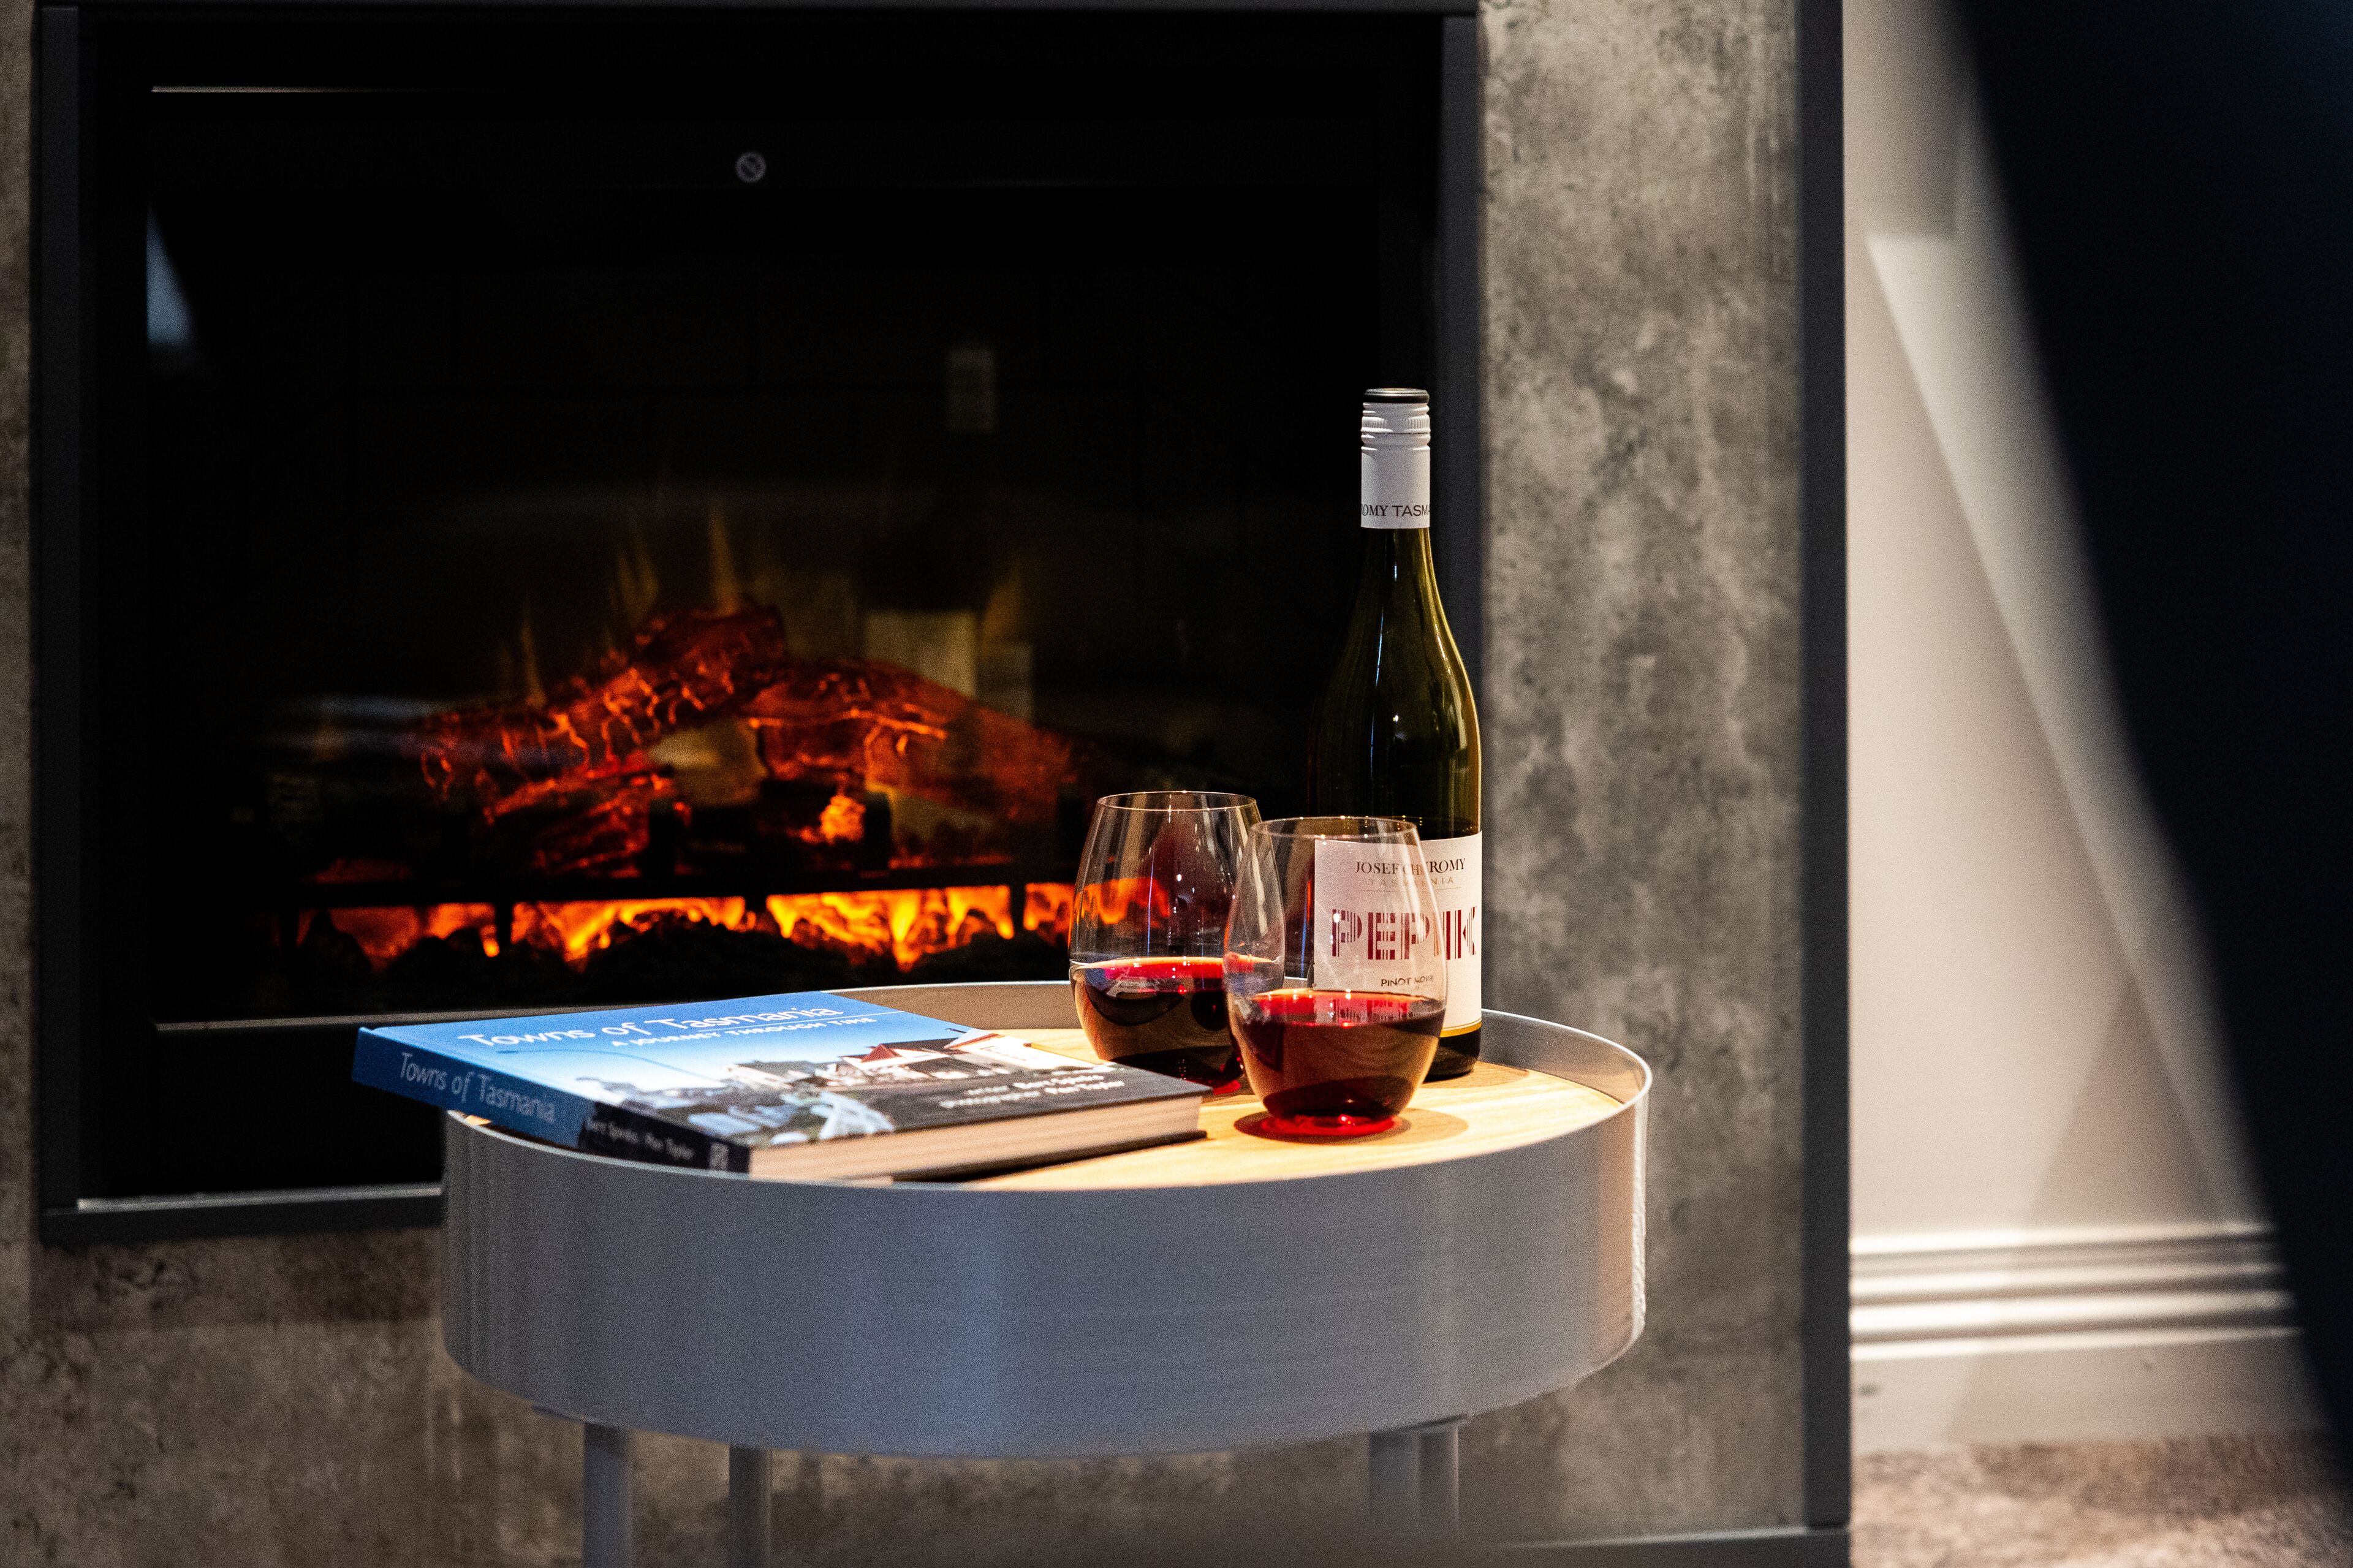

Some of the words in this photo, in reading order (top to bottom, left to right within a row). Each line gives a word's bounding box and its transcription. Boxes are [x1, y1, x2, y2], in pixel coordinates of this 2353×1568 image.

[1392, 505, 1430, 517] TASM
[1355, 862, 1400, 874] JOSEF
[1368, 876, 1455, 887] TASNIA
[1332, 906, 1477, 960] PEPIK
[1381, 977, 1411, 987] PINOT
[458, 1029, 596, 1047] Towns
[601, 1022, 651, 1036] of
[644, 1007, 844, 1030] Tasmania
[725, 1022, 827, 1036] THROUGH
[828, 1017, 877, 1026] TIME
[400, 1051, 448, 1091] Towns
[451, 1071, 476, 1104] of
[477, 1074, 555, 1123] Tasmania
